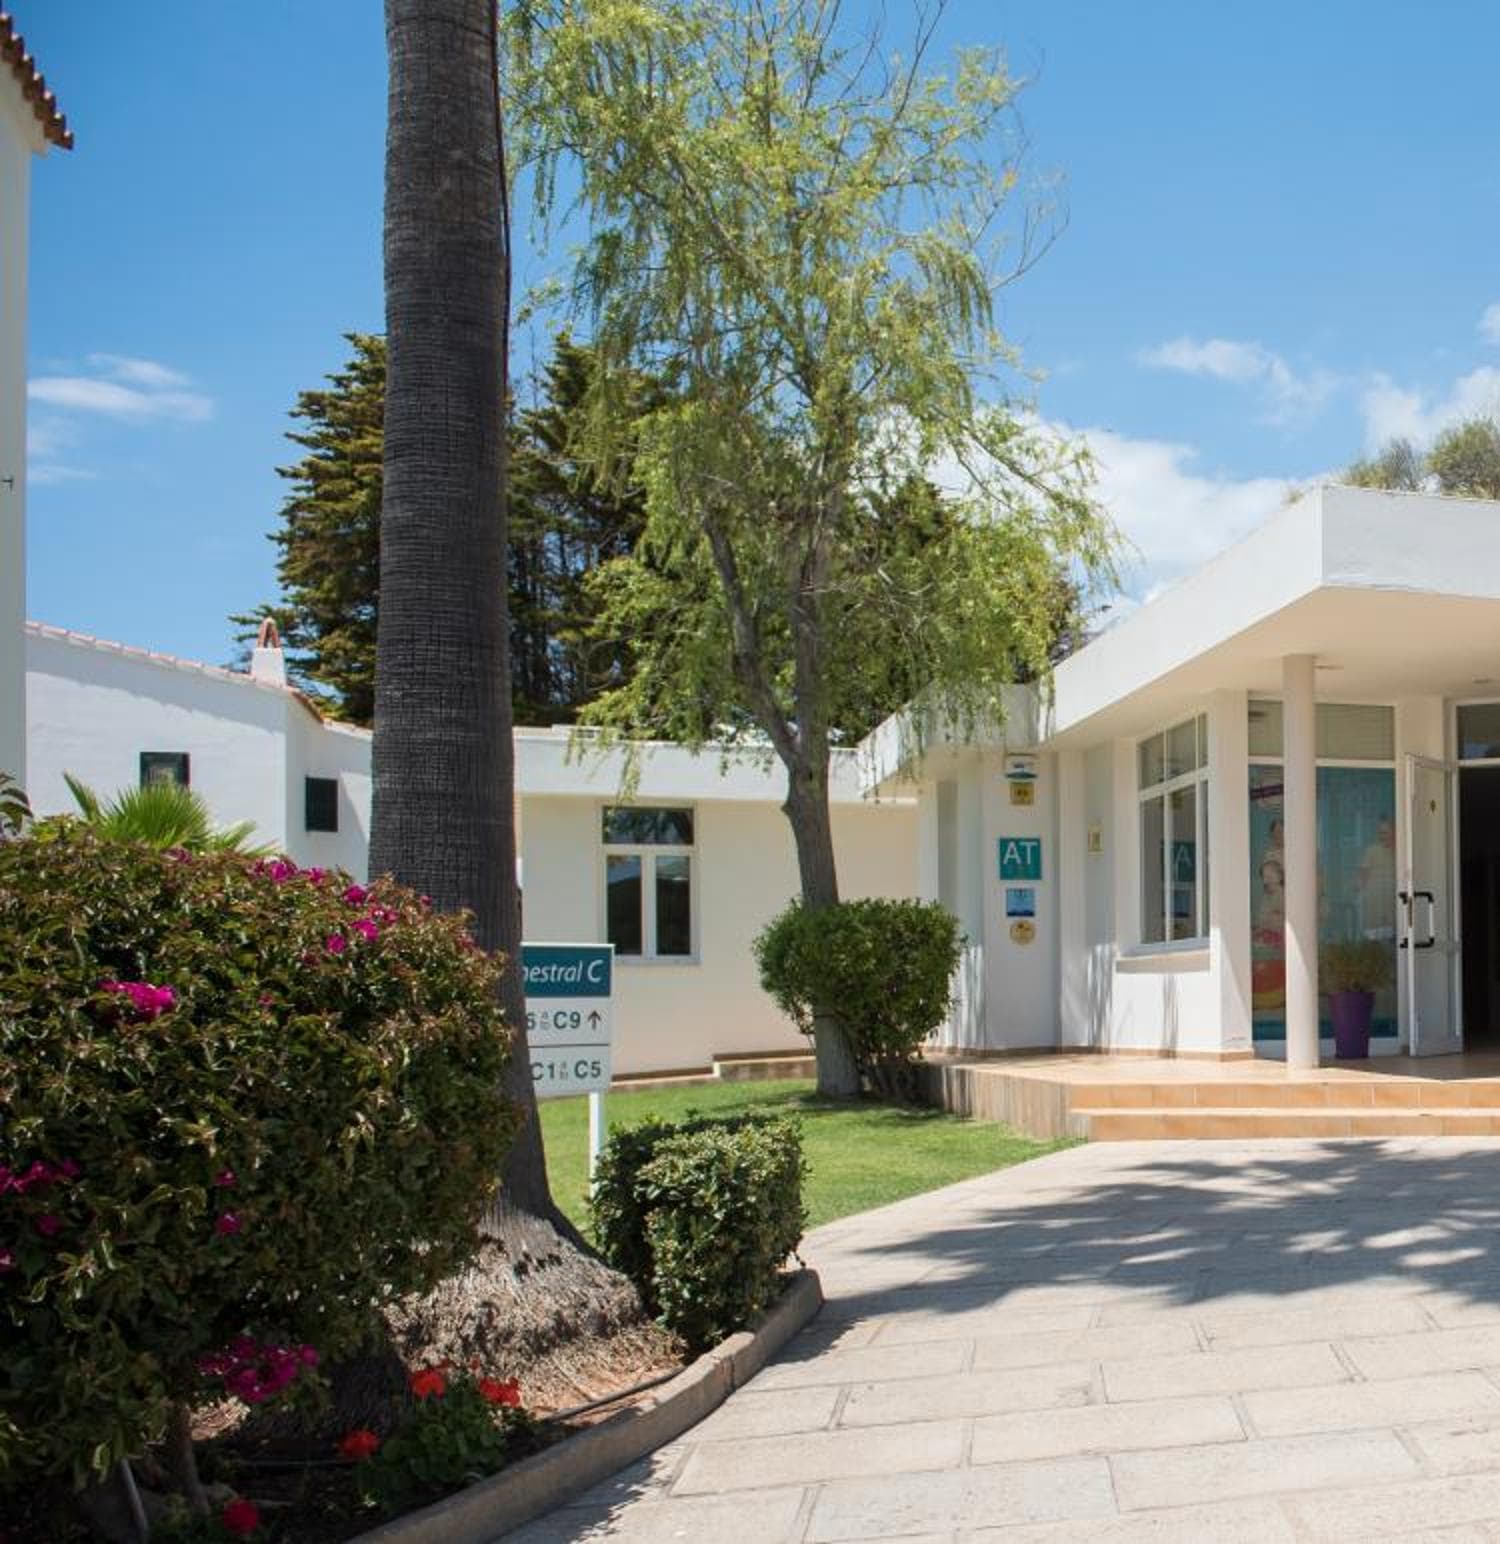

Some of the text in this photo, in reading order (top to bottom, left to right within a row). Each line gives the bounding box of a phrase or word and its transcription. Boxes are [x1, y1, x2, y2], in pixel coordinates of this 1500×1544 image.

[1003, 841, 1038, 865] AT
[587, 959, 604, 983] C
[553, 1011, 581, 1030] C9
[530, 1062, 556, 1080] C1
[574, 1060, 602, 1079] C5
